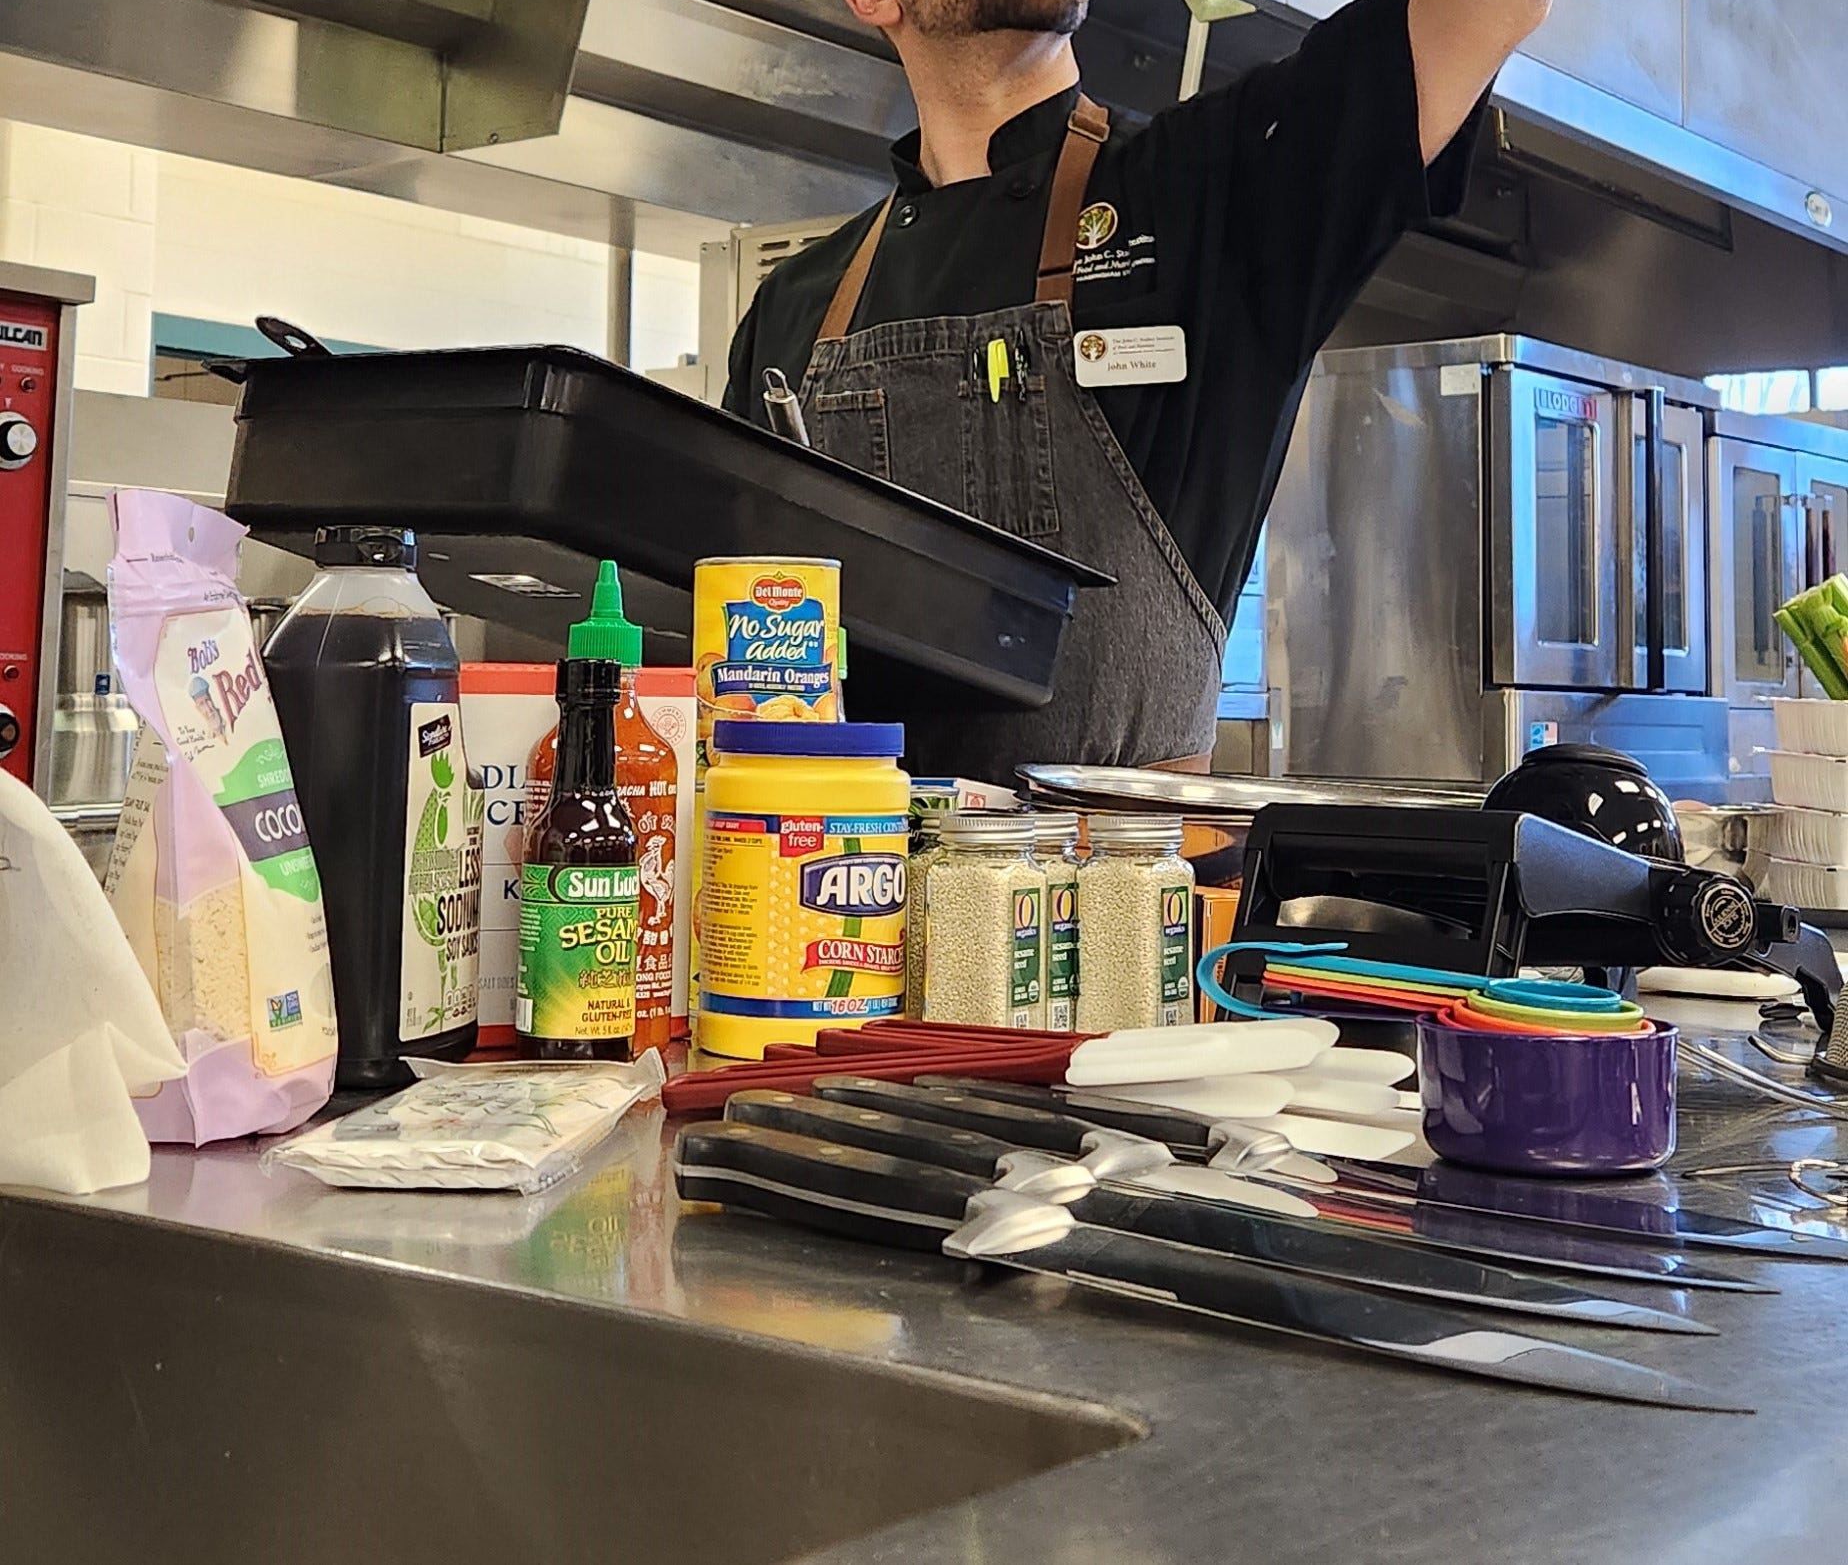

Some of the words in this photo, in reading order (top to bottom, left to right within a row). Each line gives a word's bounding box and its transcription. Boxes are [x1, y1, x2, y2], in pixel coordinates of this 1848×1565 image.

[1107, 362, 1127, 371] John
[1130, 360, 1156, 369] White
[755, 586, 771, 597] Del
[772, 586, 803, 597] Monte
[729, 614, 760, 639] No
[761, 615, 824, 644] Sugar
[717, 665, 780, 683] Mandarin
[784, 668, 829, 688] Oranges
[211, 646, 262, 734] Red
[480, 764, 526, 789] DI
[649, 780, 667, 796] HOT
[780, 819, 824, 834] gluten-
[829, 822, 881, 834] STAY-FRESH
[788, 834, 817, 847] free
[458, 847, 480, 888] LESS
[568, 871, 610, 897] Sun
[816, 864, 906, 906] ARGO
[595, 906, 633, 919] PURE
[559, 918, 639, 949] SESAM
[595, 940, 630, 964] OIL
[818, 940, 865, 961] CORN
[588, 998, 624, 1010] NATURAL
[832, 999, 845, 1012] 16
